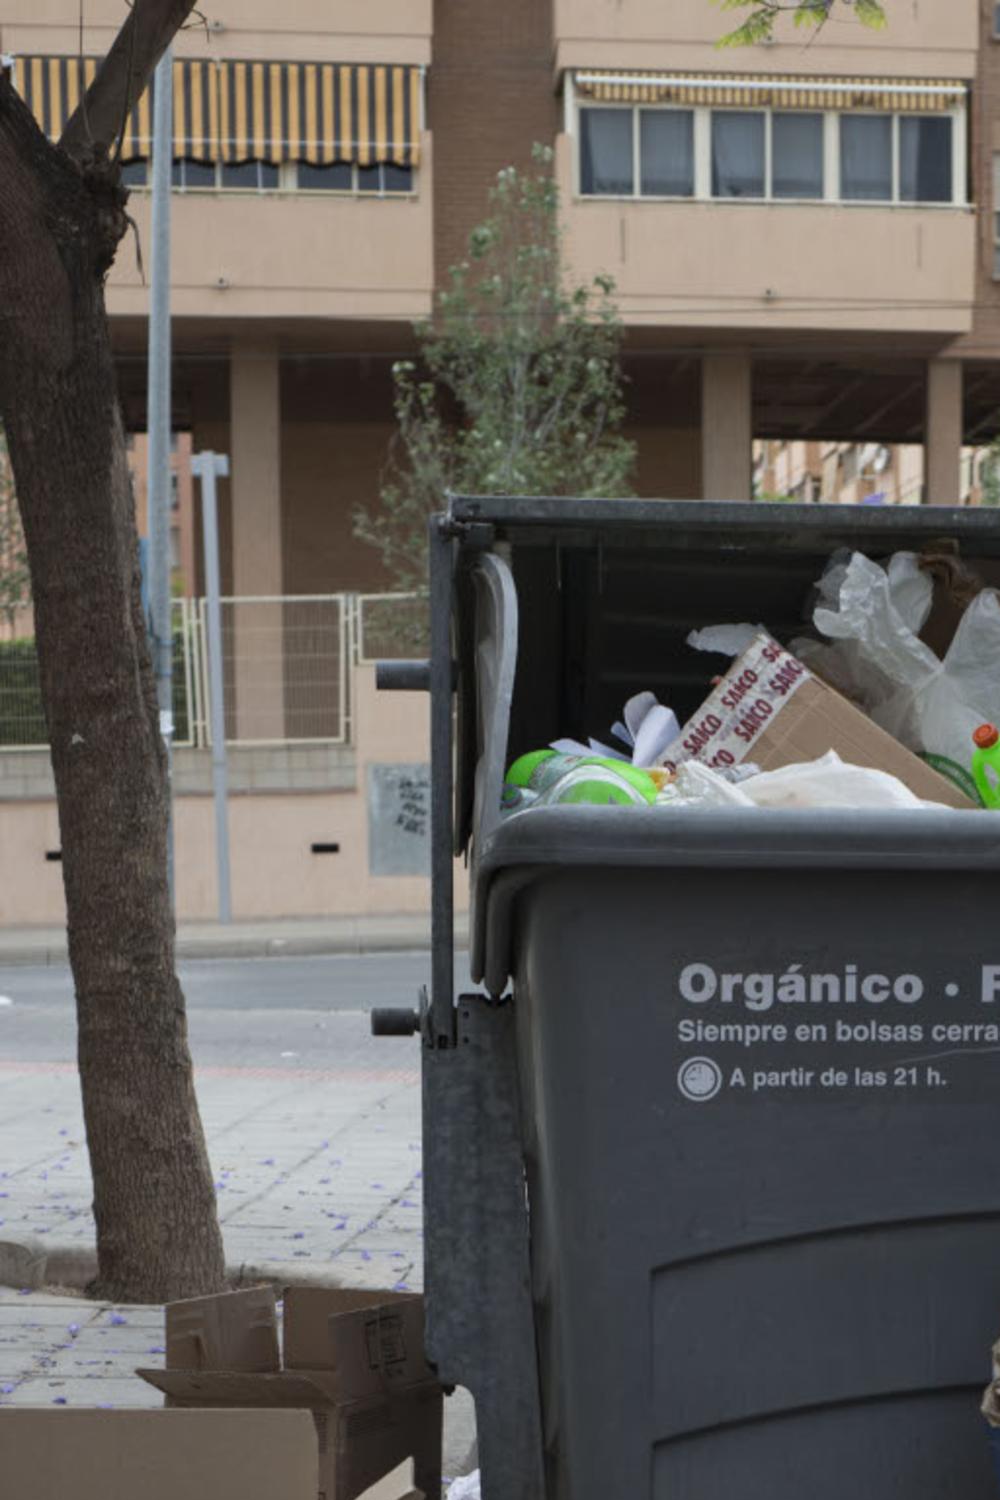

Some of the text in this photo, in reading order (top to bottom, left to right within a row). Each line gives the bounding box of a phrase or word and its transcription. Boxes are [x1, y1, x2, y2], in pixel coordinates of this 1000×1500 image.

[678, 962, 924, 1011] Orgánico
[677, 1019, 788, 1047] Siempre
[794, 1024, 827, 1042] en
[836, 1019, 924, 1042] bolsas
[729, 1067, 948, 1091] A partir de las 21 h.
